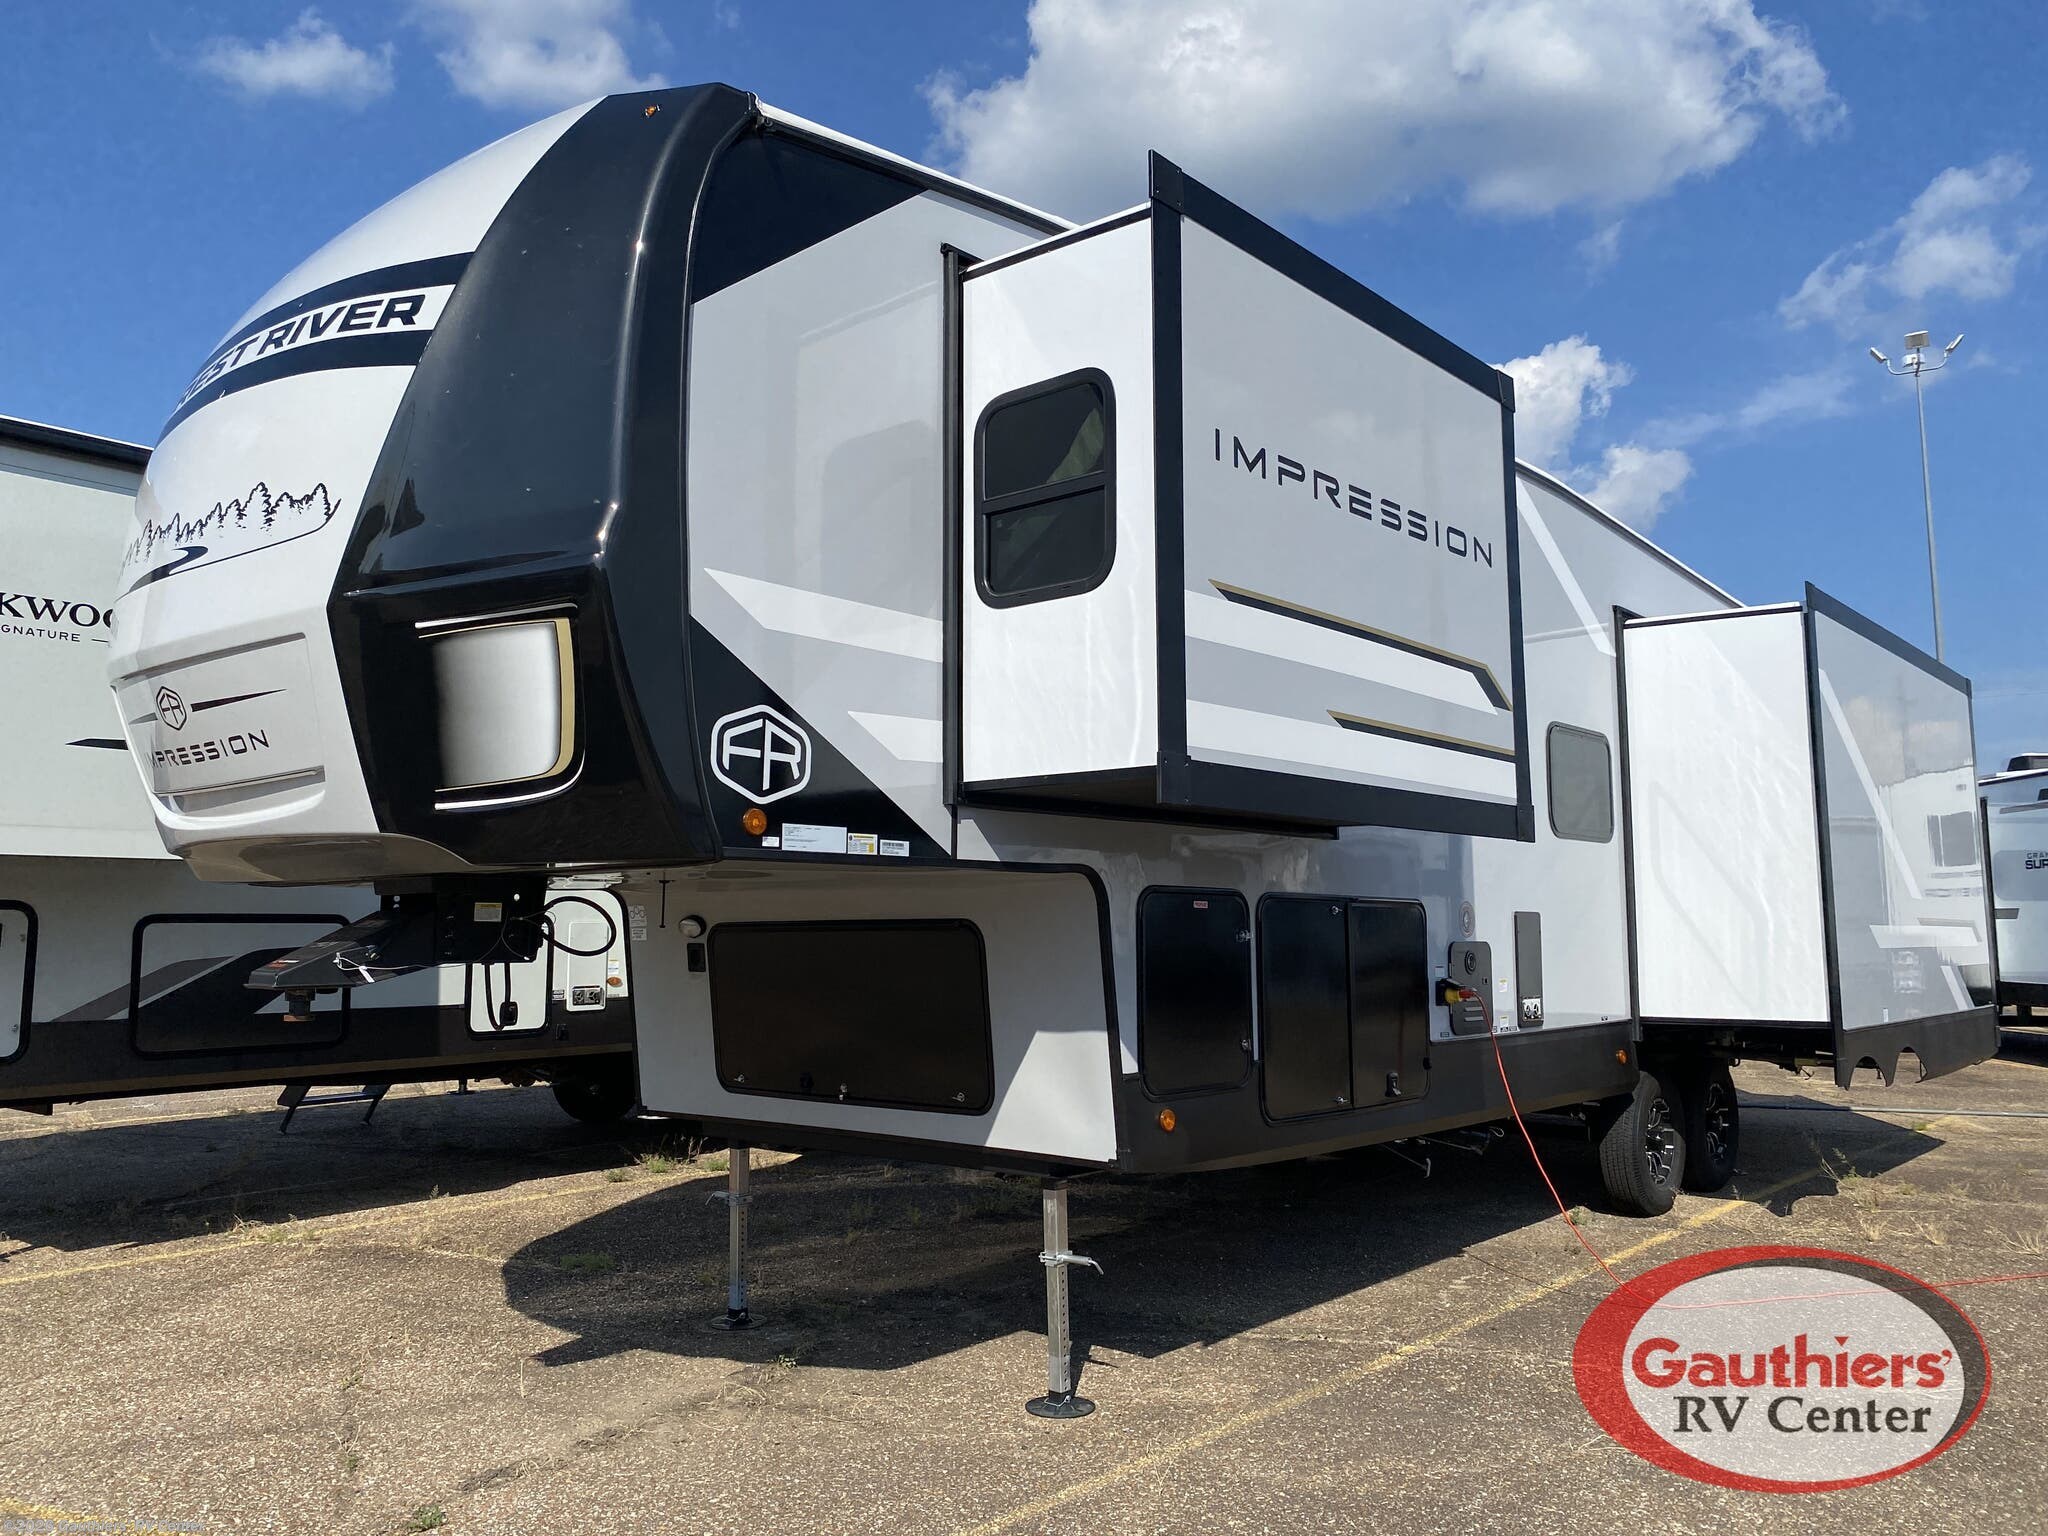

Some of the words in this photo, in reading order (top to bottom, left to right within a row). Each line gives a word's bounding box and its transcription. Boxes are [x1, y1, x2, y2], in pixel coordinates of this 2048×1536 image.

[257, 294, 426, 356] RIVER
[1214, 427, 1493, 568] IMPRESSION
[1, 623, 81, 643] GNATURE
